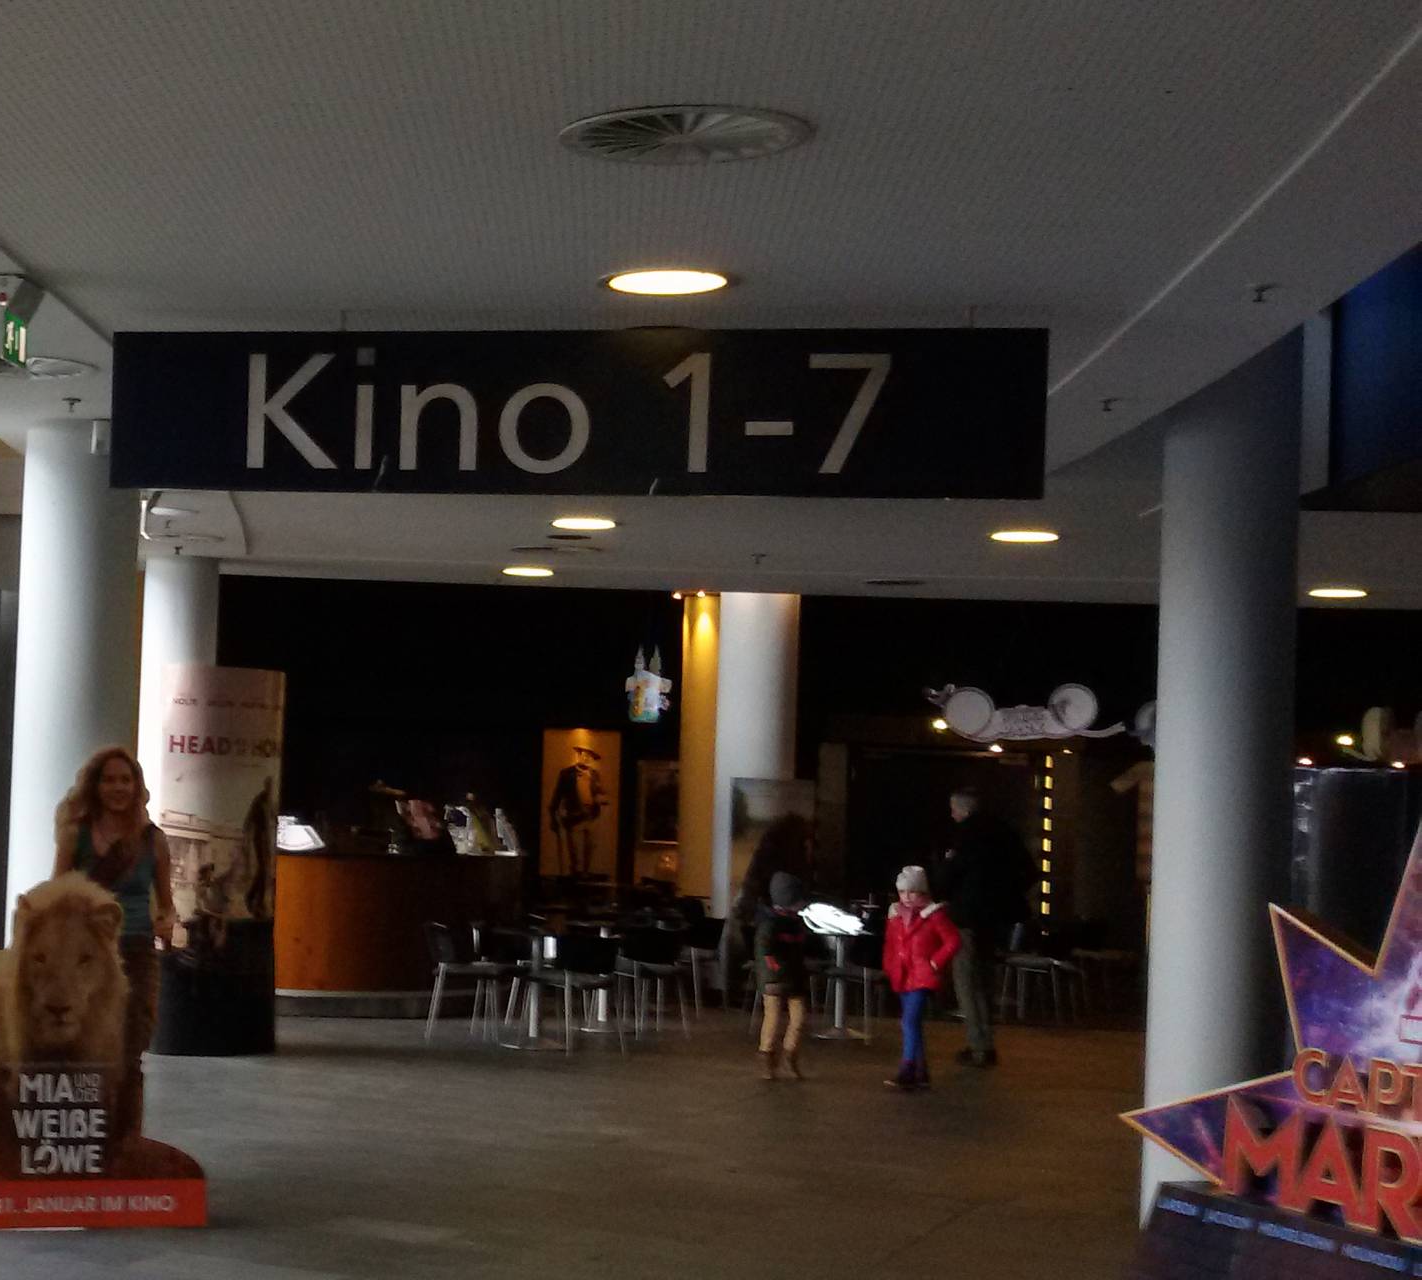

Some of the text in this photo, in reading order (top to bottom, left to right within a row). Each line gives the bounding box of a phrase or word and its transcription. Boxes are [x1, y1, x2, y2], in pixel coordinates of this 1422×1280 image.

[246, 348, 893, 474] Kino 1-7
[168, 735, 231, 756] HEAD
[19, 1073, 101, 1103] MIA UND
[20, 1139, 103, 1174] LÖWE
[1221, 1096, 1422, 1245] MAR
[24, 1195, 95, 1213] JANUAR
[101, 1196, 123, 1211] IM
[128, 1194, 174, 1211] KINO
